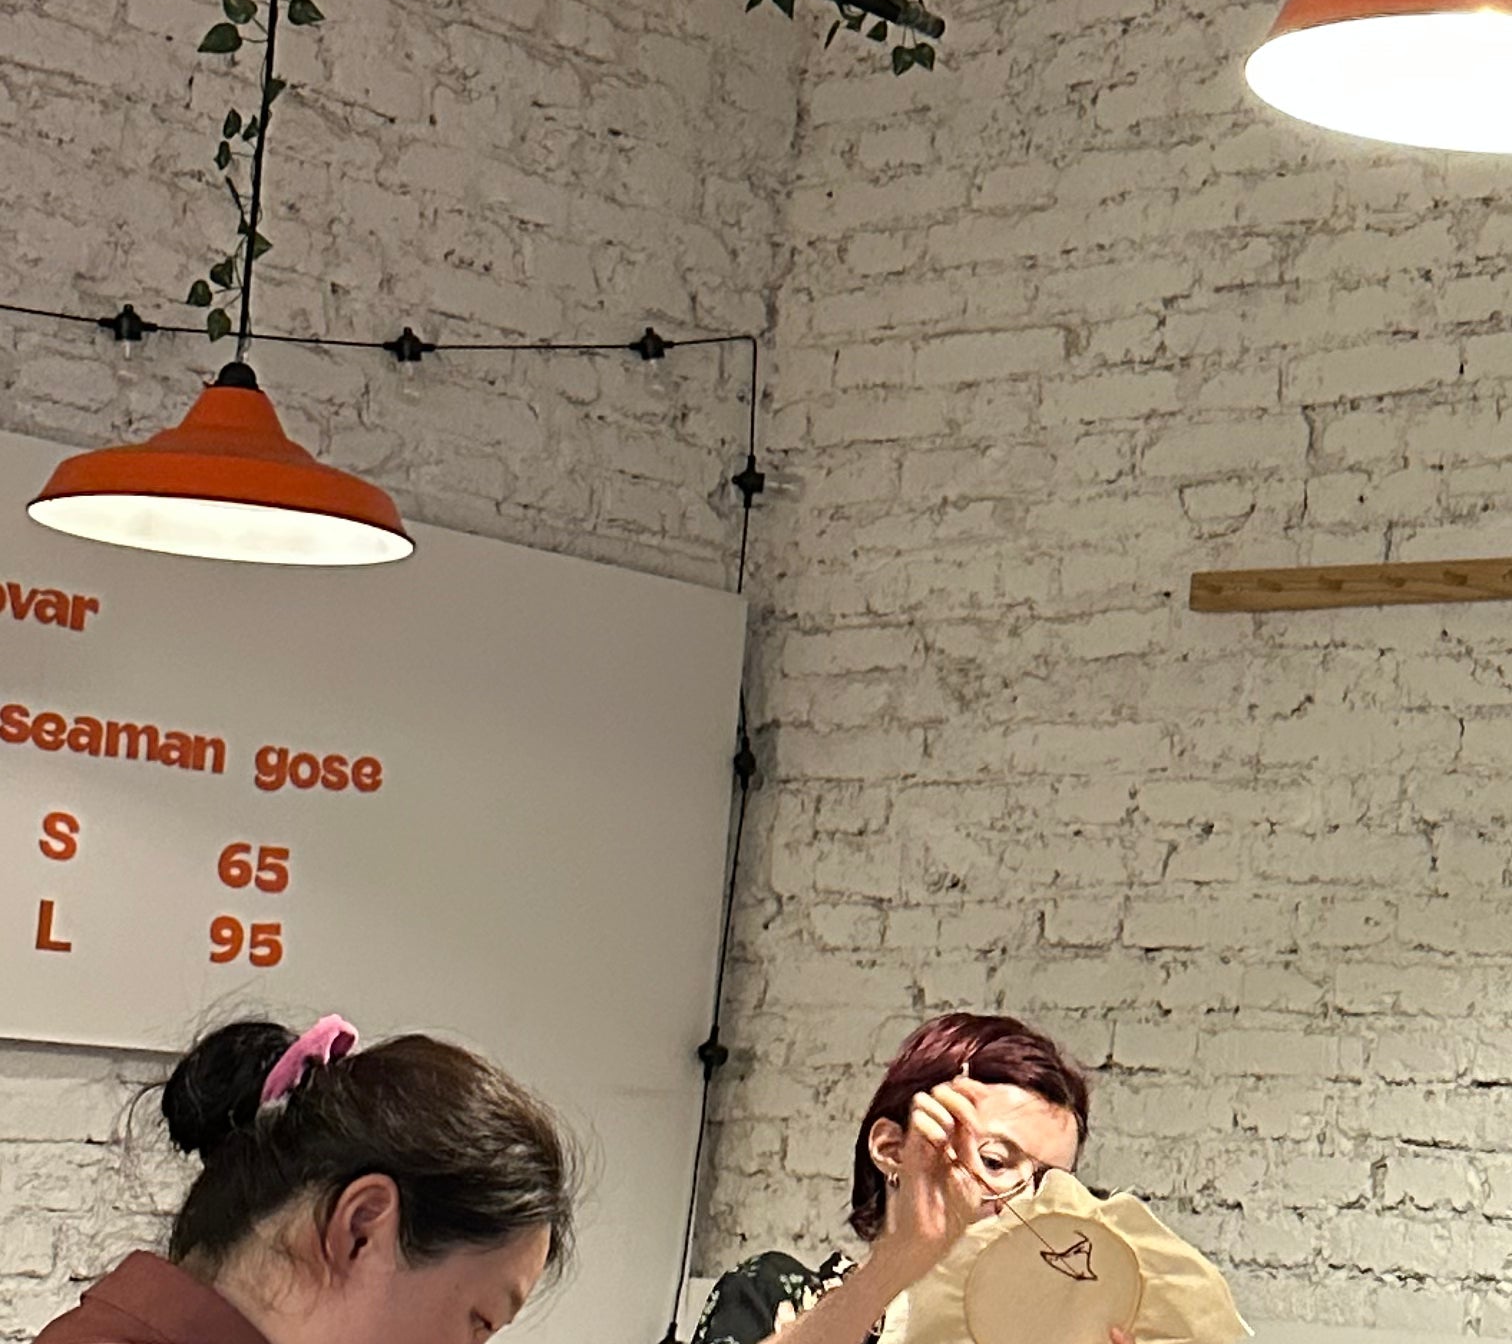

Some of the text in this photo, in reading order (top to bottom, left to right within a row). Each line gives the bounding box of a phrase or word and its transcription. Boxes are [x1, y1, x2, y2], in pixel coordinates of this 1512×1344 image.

[0, 582, 100, 632] var
[0, 703, 384, 793] seaman gose
[38, 810, 291, 894] S 65
[35, 899, 285, 968] L 95
